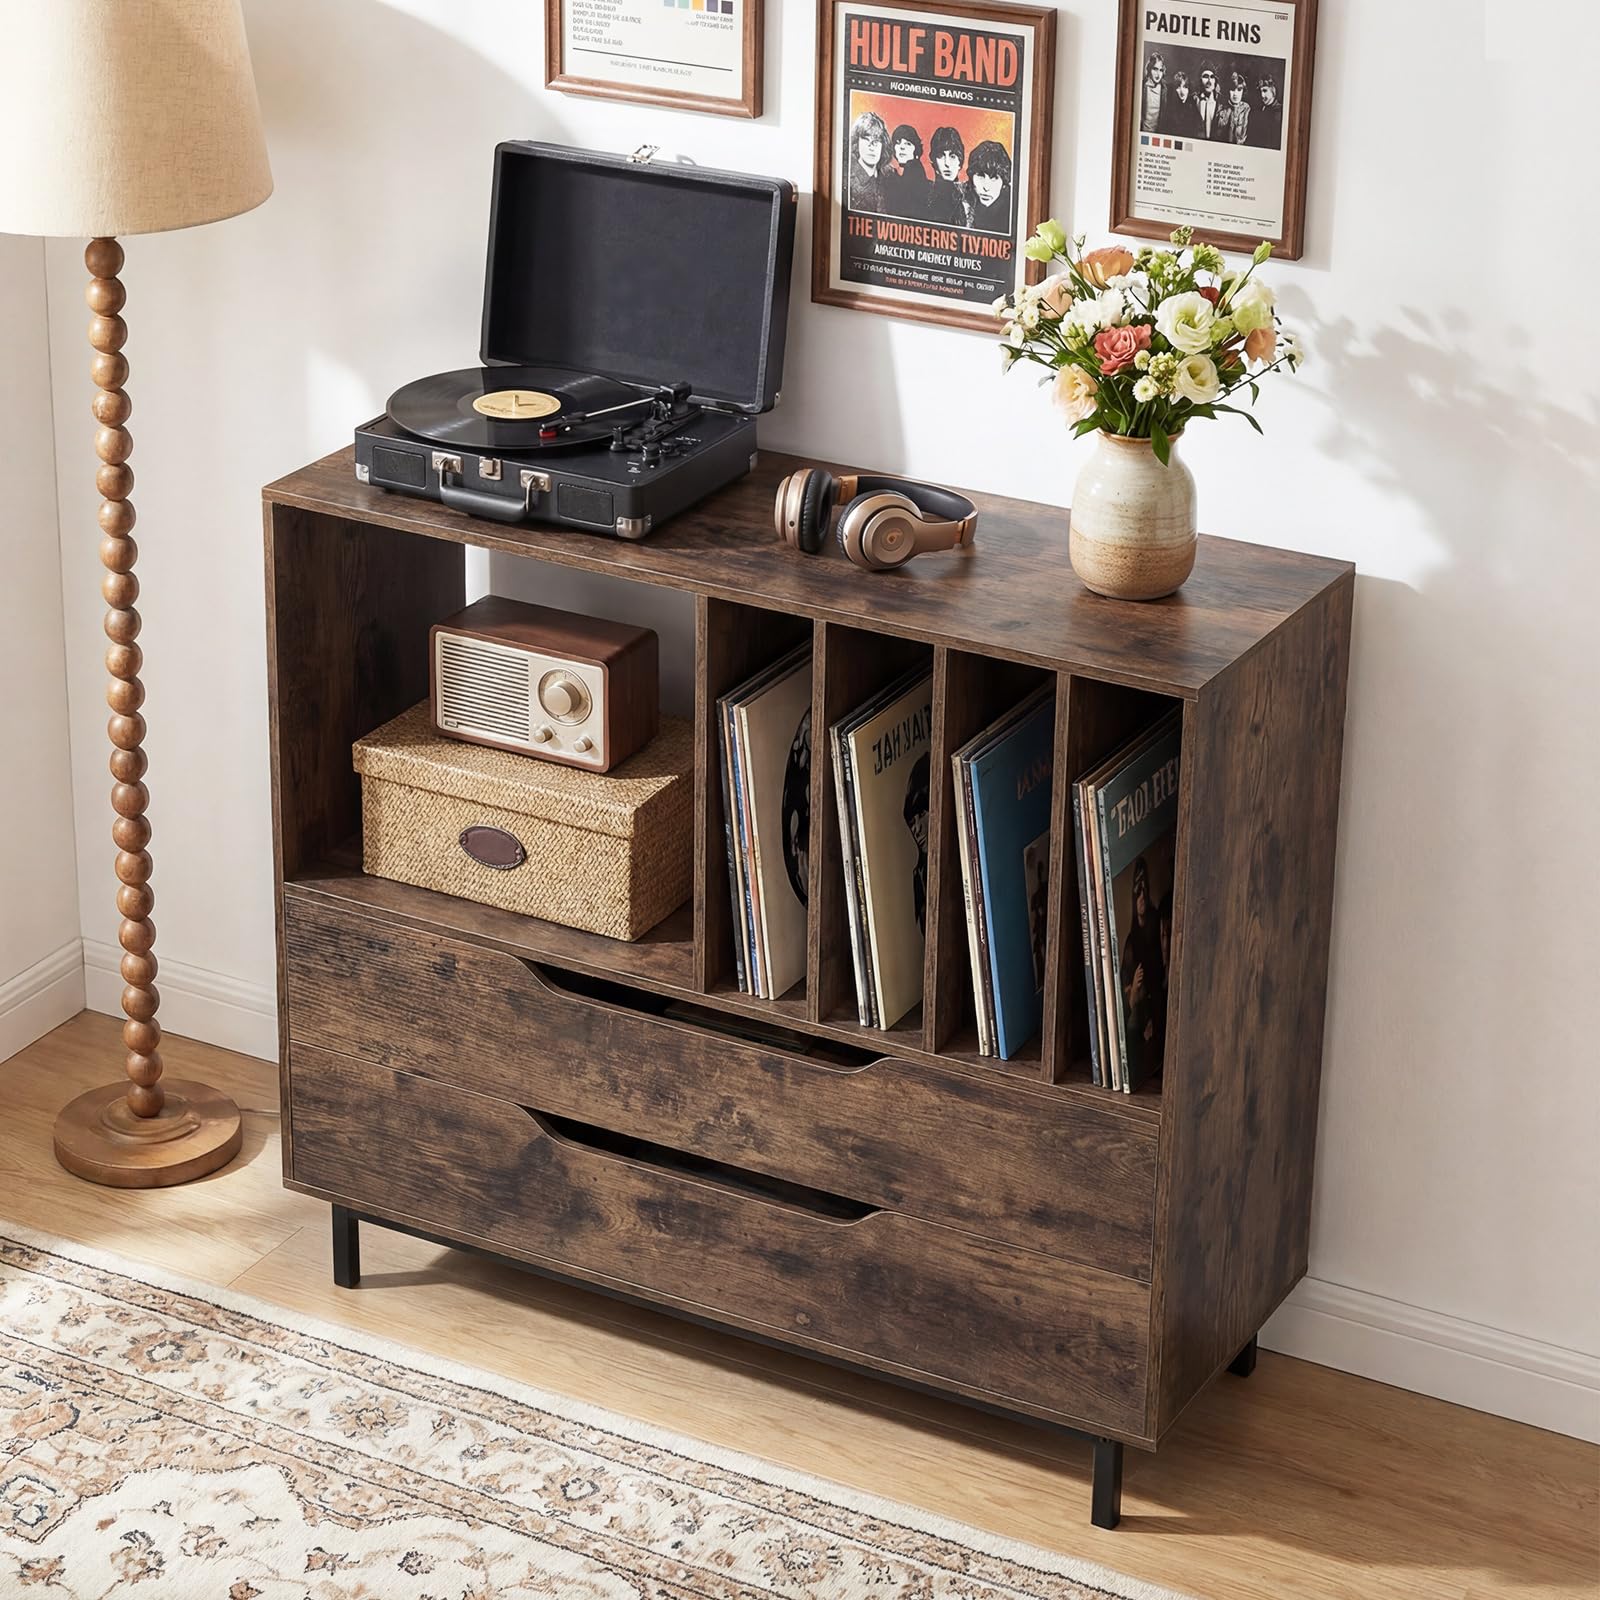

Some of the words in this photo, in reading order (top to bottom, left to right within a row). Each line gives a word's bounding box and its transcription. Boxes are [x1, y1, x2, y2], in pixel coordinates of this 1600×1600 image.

[1145, 10, 1211, 38] PADTLE
[1217, 20, 1261, 44] RINS
[850, 19, 926, 73] HULF
[934, 31, 1018, 87] BAND
[847, 216, 873, 238] THE
